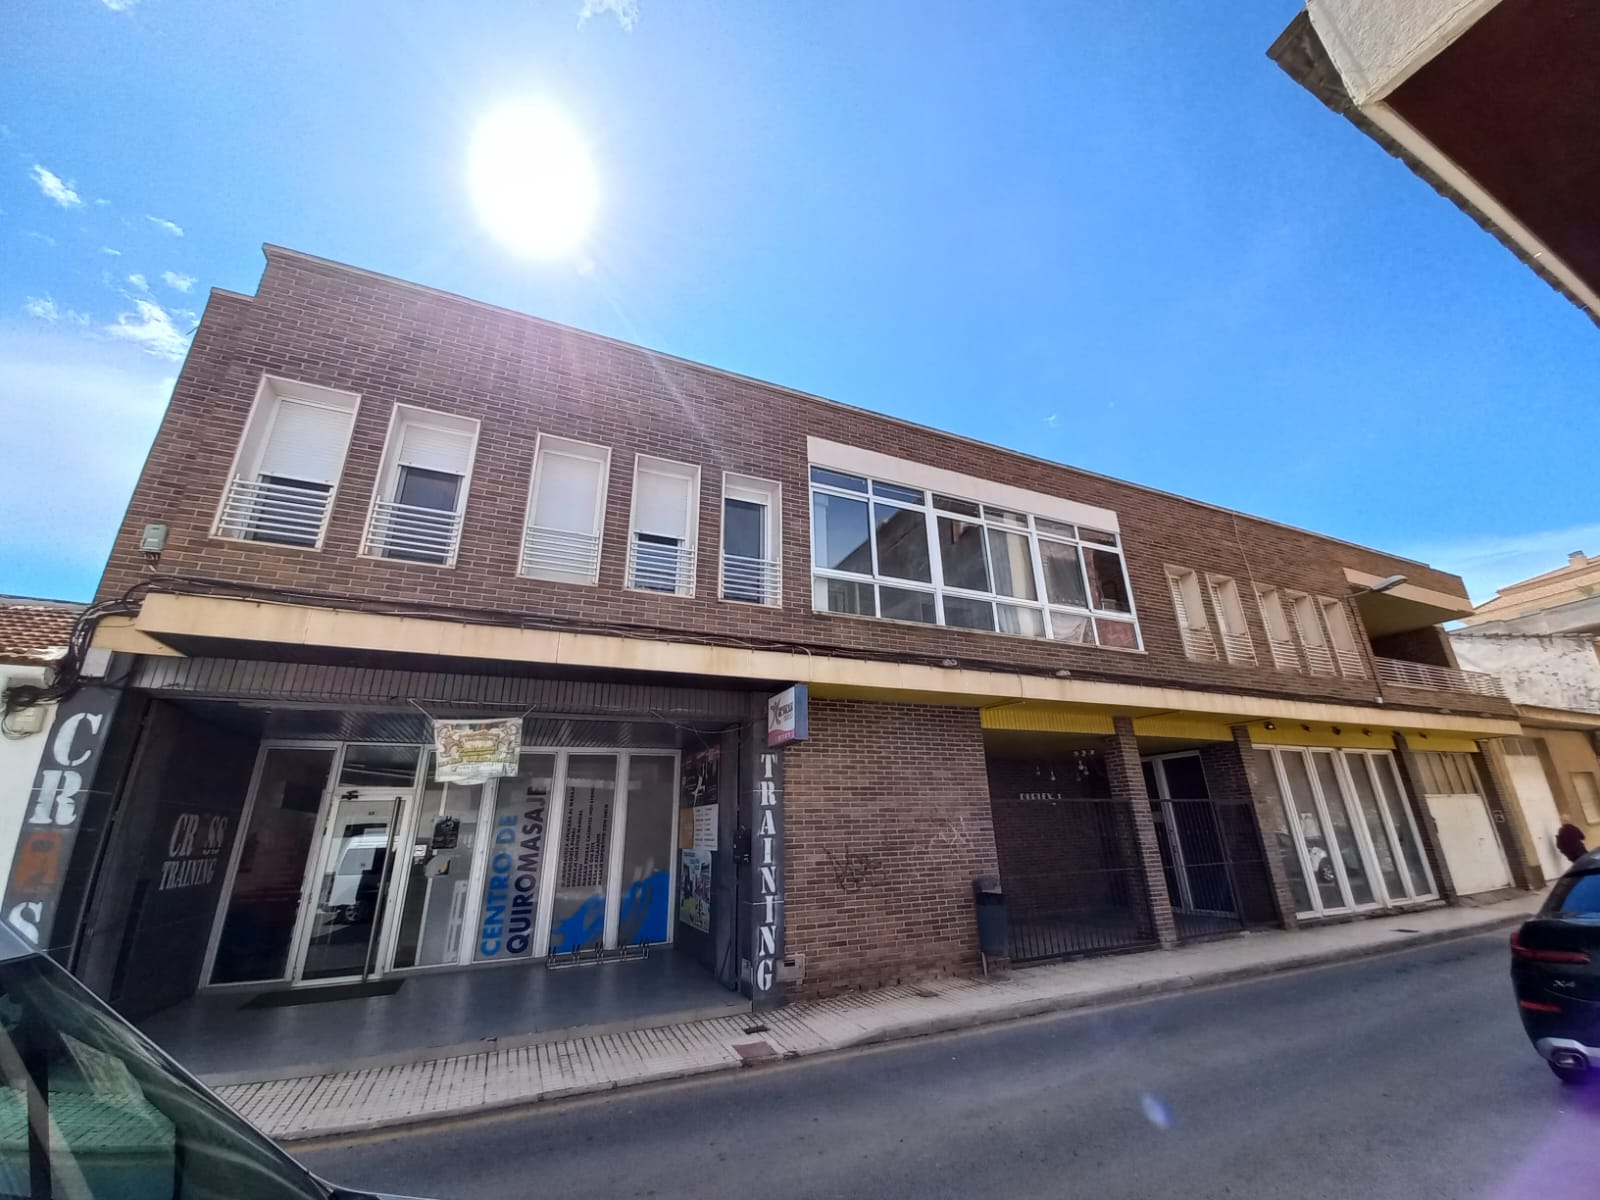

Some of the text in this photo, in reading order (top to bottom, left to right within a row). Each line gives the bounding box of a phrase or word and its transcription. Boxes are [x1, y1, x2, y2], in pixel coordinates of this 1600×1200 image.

[158, 858, 217, 891] TRAINING
[480, 815, 518, 957] CENTRO DE
[506, 785, 547, 954] QUIROMASAJE
[757, 753, 778, 991] TRAINING
